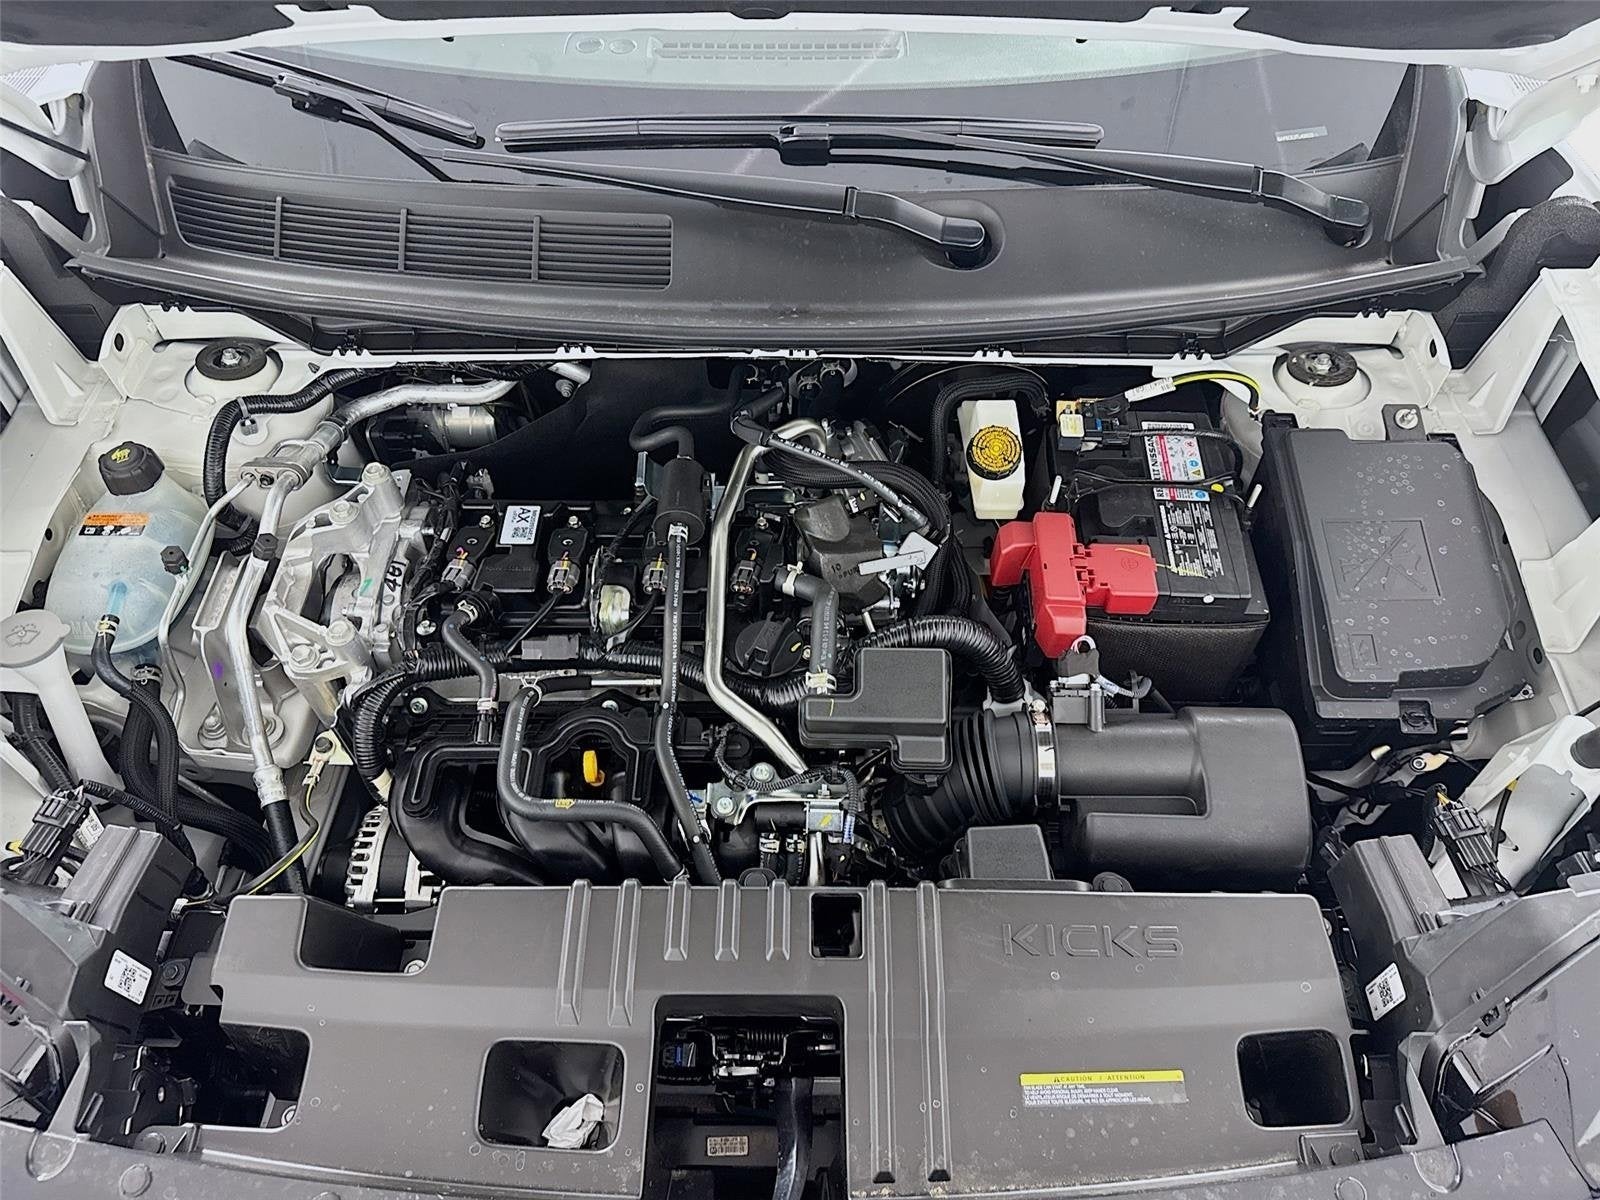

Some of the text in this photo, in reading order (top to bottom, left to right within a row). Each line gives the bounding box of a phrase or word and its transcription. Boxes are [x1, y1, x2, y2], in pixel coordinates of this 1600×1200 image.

[1146, 435, 1158, 469] NISSAN
[516, 507, 531, 524] AX
[1002, 923, 1184, 959] KICKS
[1107, 1073, 1145, 1081] ATTENTION
